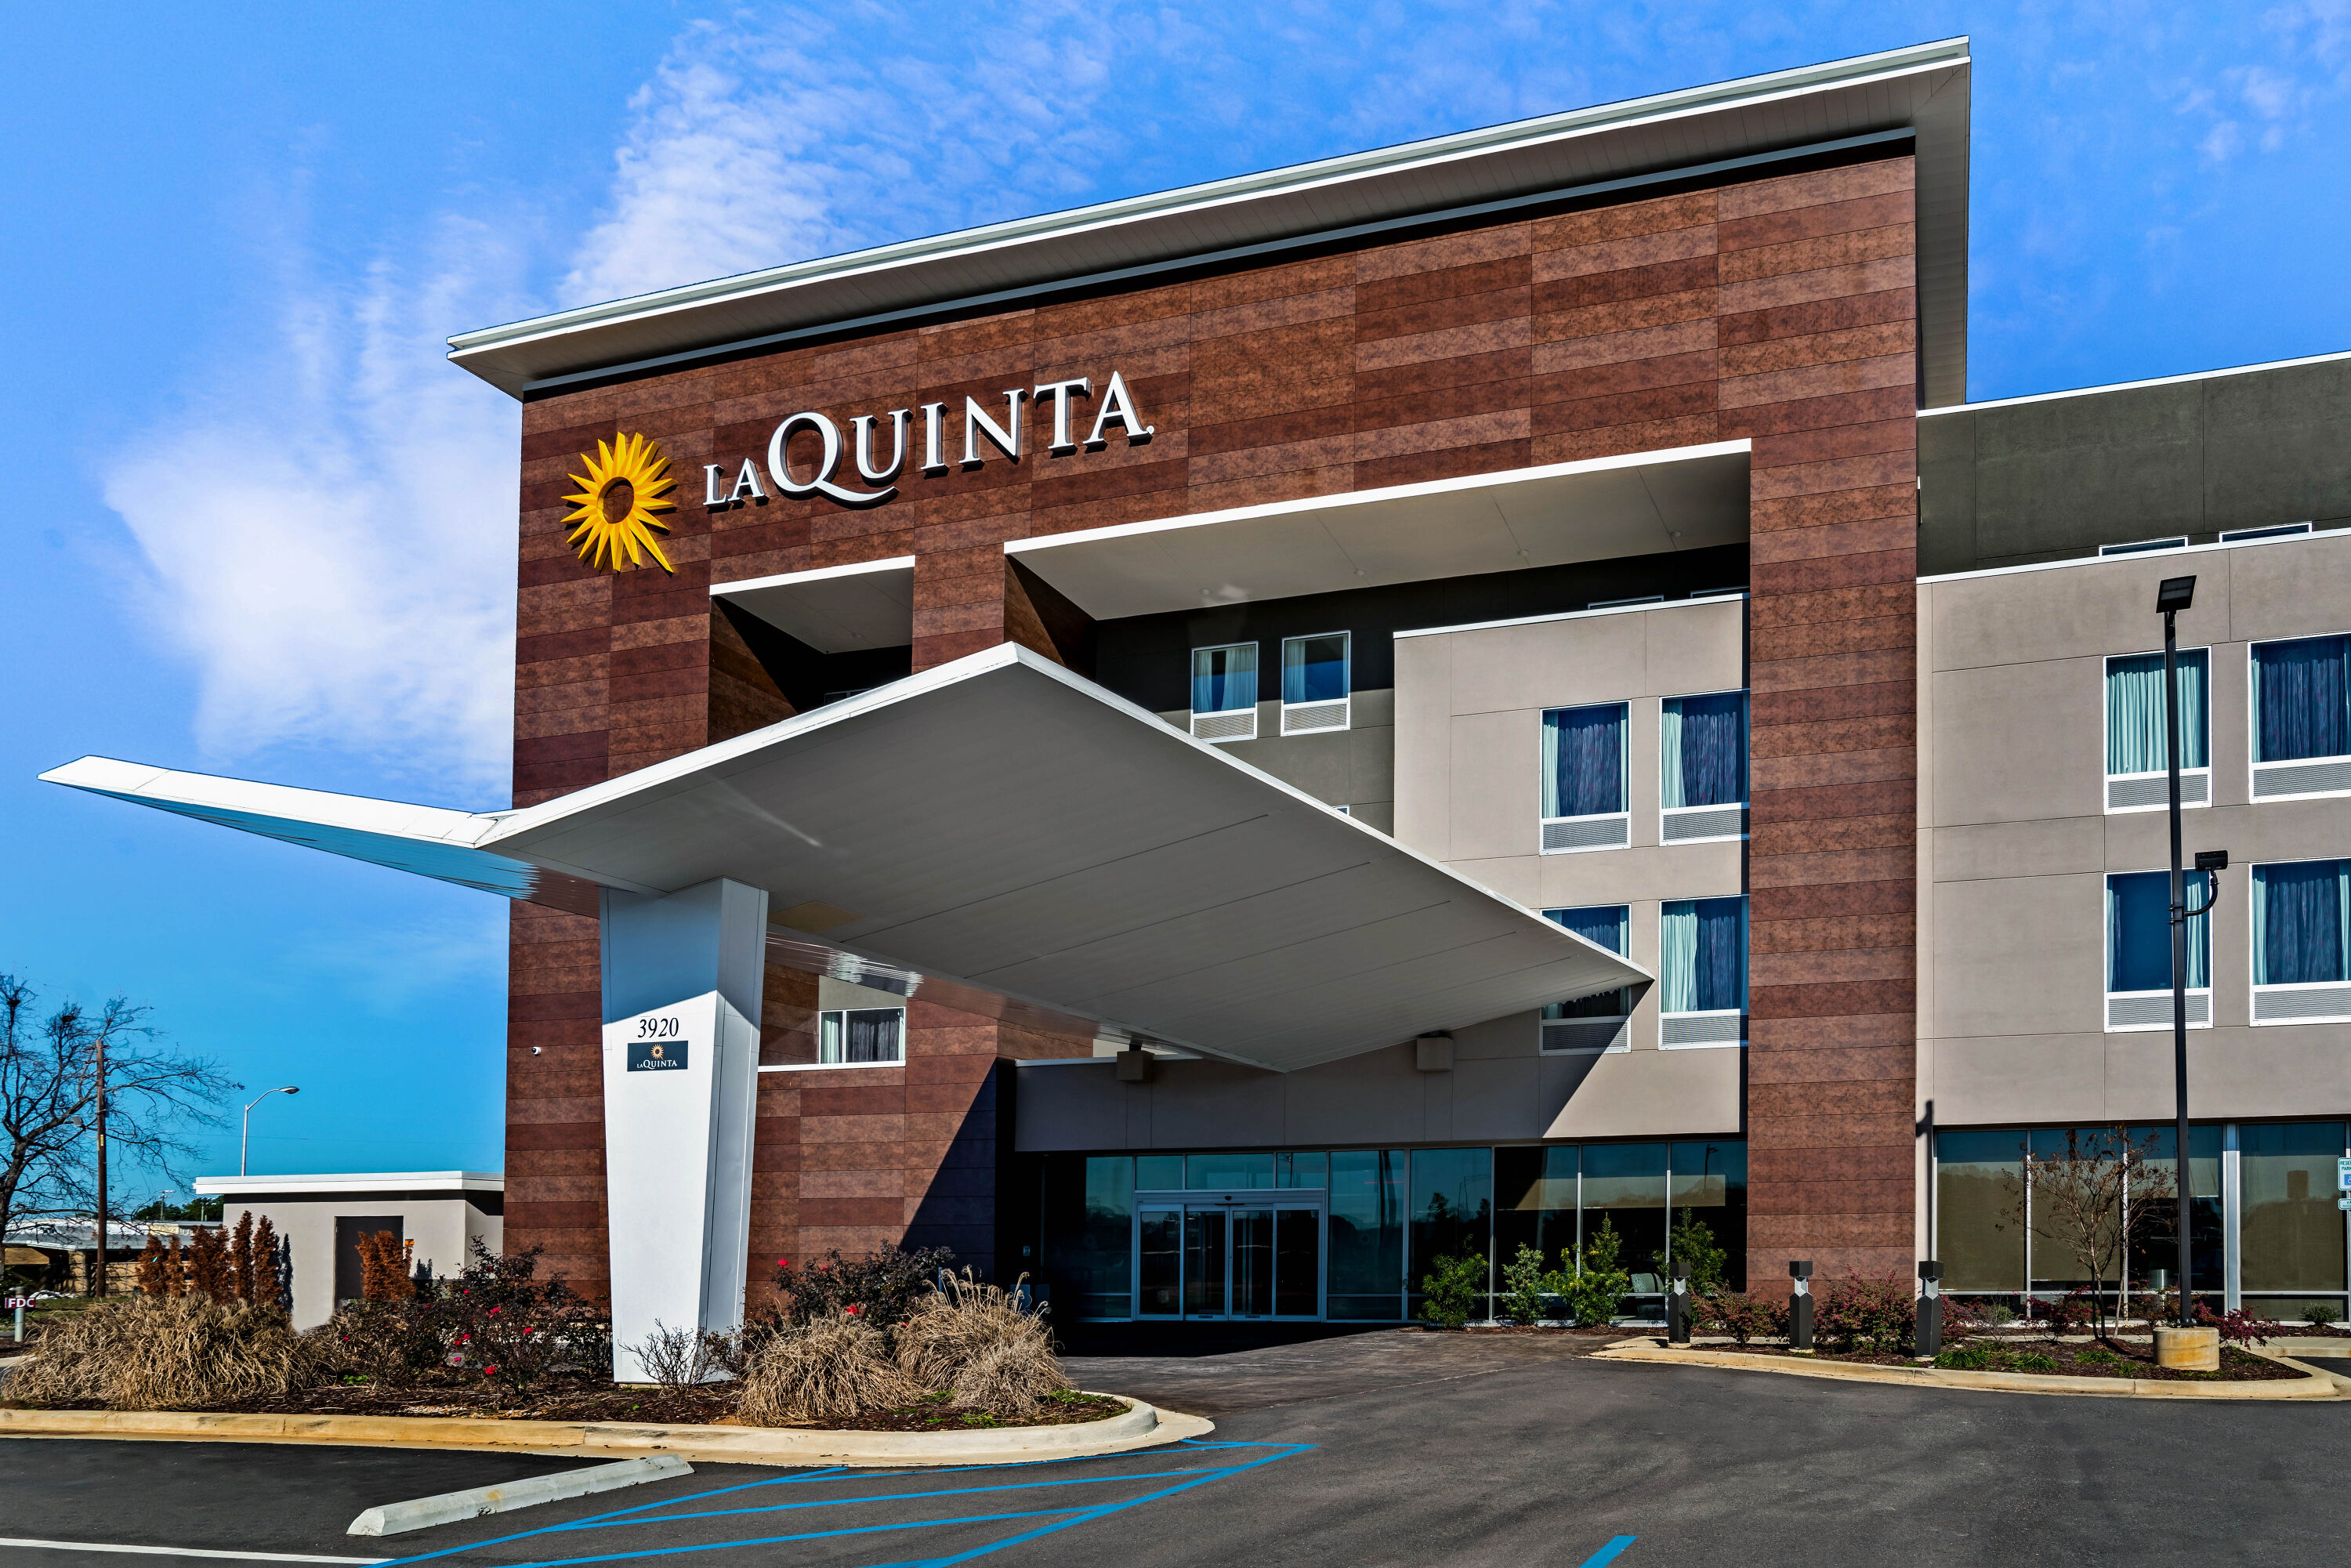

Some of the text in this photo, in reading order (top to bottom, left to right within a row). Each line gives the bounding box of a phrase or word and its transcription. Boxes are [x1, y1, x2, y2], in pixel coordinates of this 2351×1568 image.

[703, 370, 1155, 506] LA QUINTA
[637, 1017, 679, 1038] 3920
[643, 1059, 678, 1070] QUINTA
[9, 1298, 34, 1308] FDC
